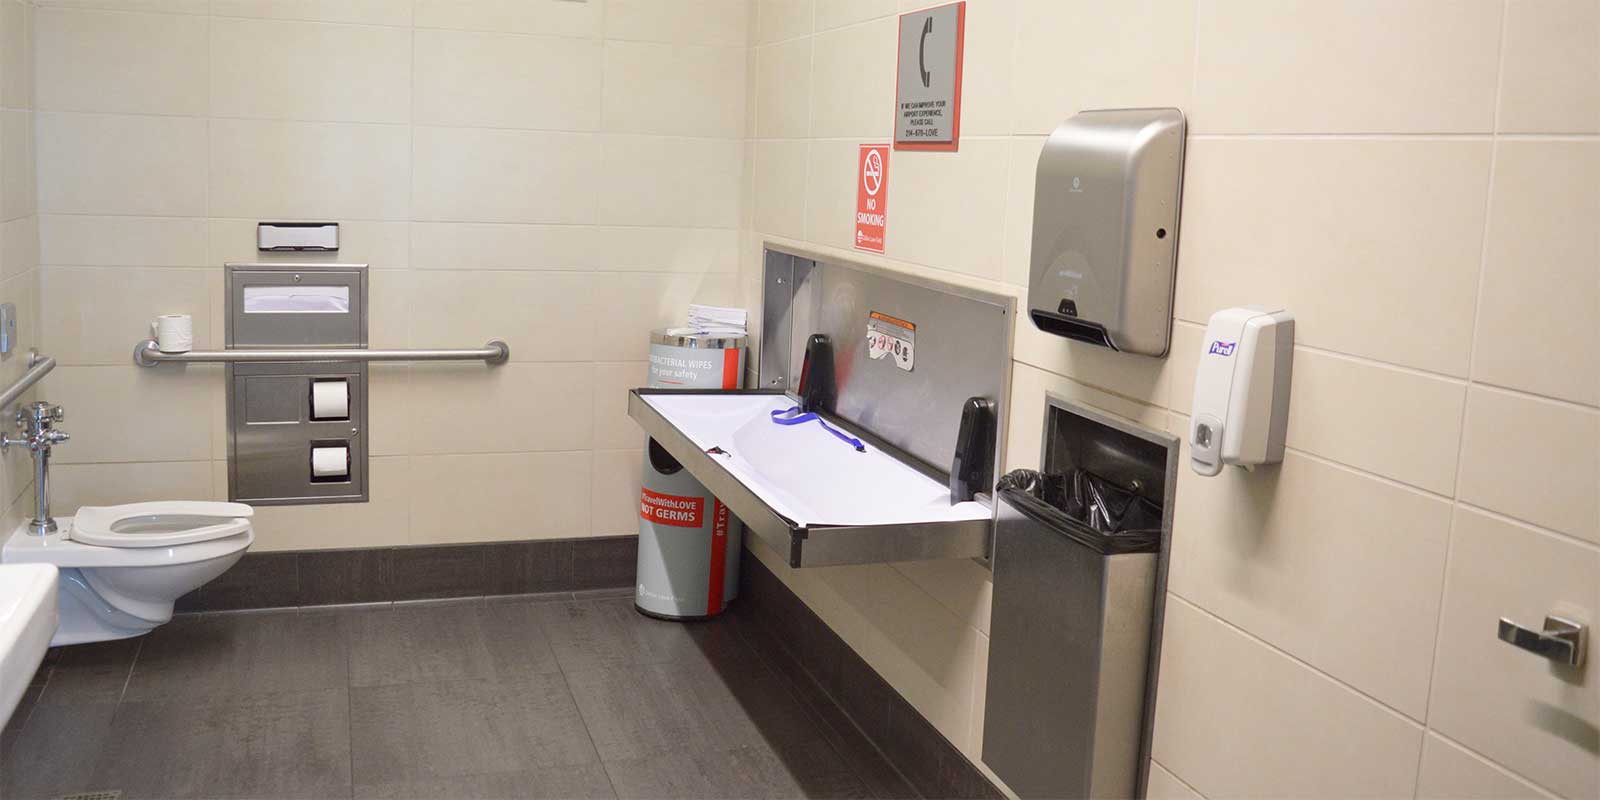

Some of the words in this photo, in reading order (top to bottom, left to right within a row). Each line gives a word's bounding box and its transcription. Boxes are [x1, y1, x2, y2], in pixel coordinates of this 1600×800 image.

[910, 118, 924, 126] PLEASE
[867, 199, 876, 210] NO
[857, 212, 884, 226] SMOKING
[688, 359, 713, 369] WIPES
[674, 369, 697, 381] safety
[641, 503, 654, 515] NOT
[655, 508, 696, 522] GERMS
